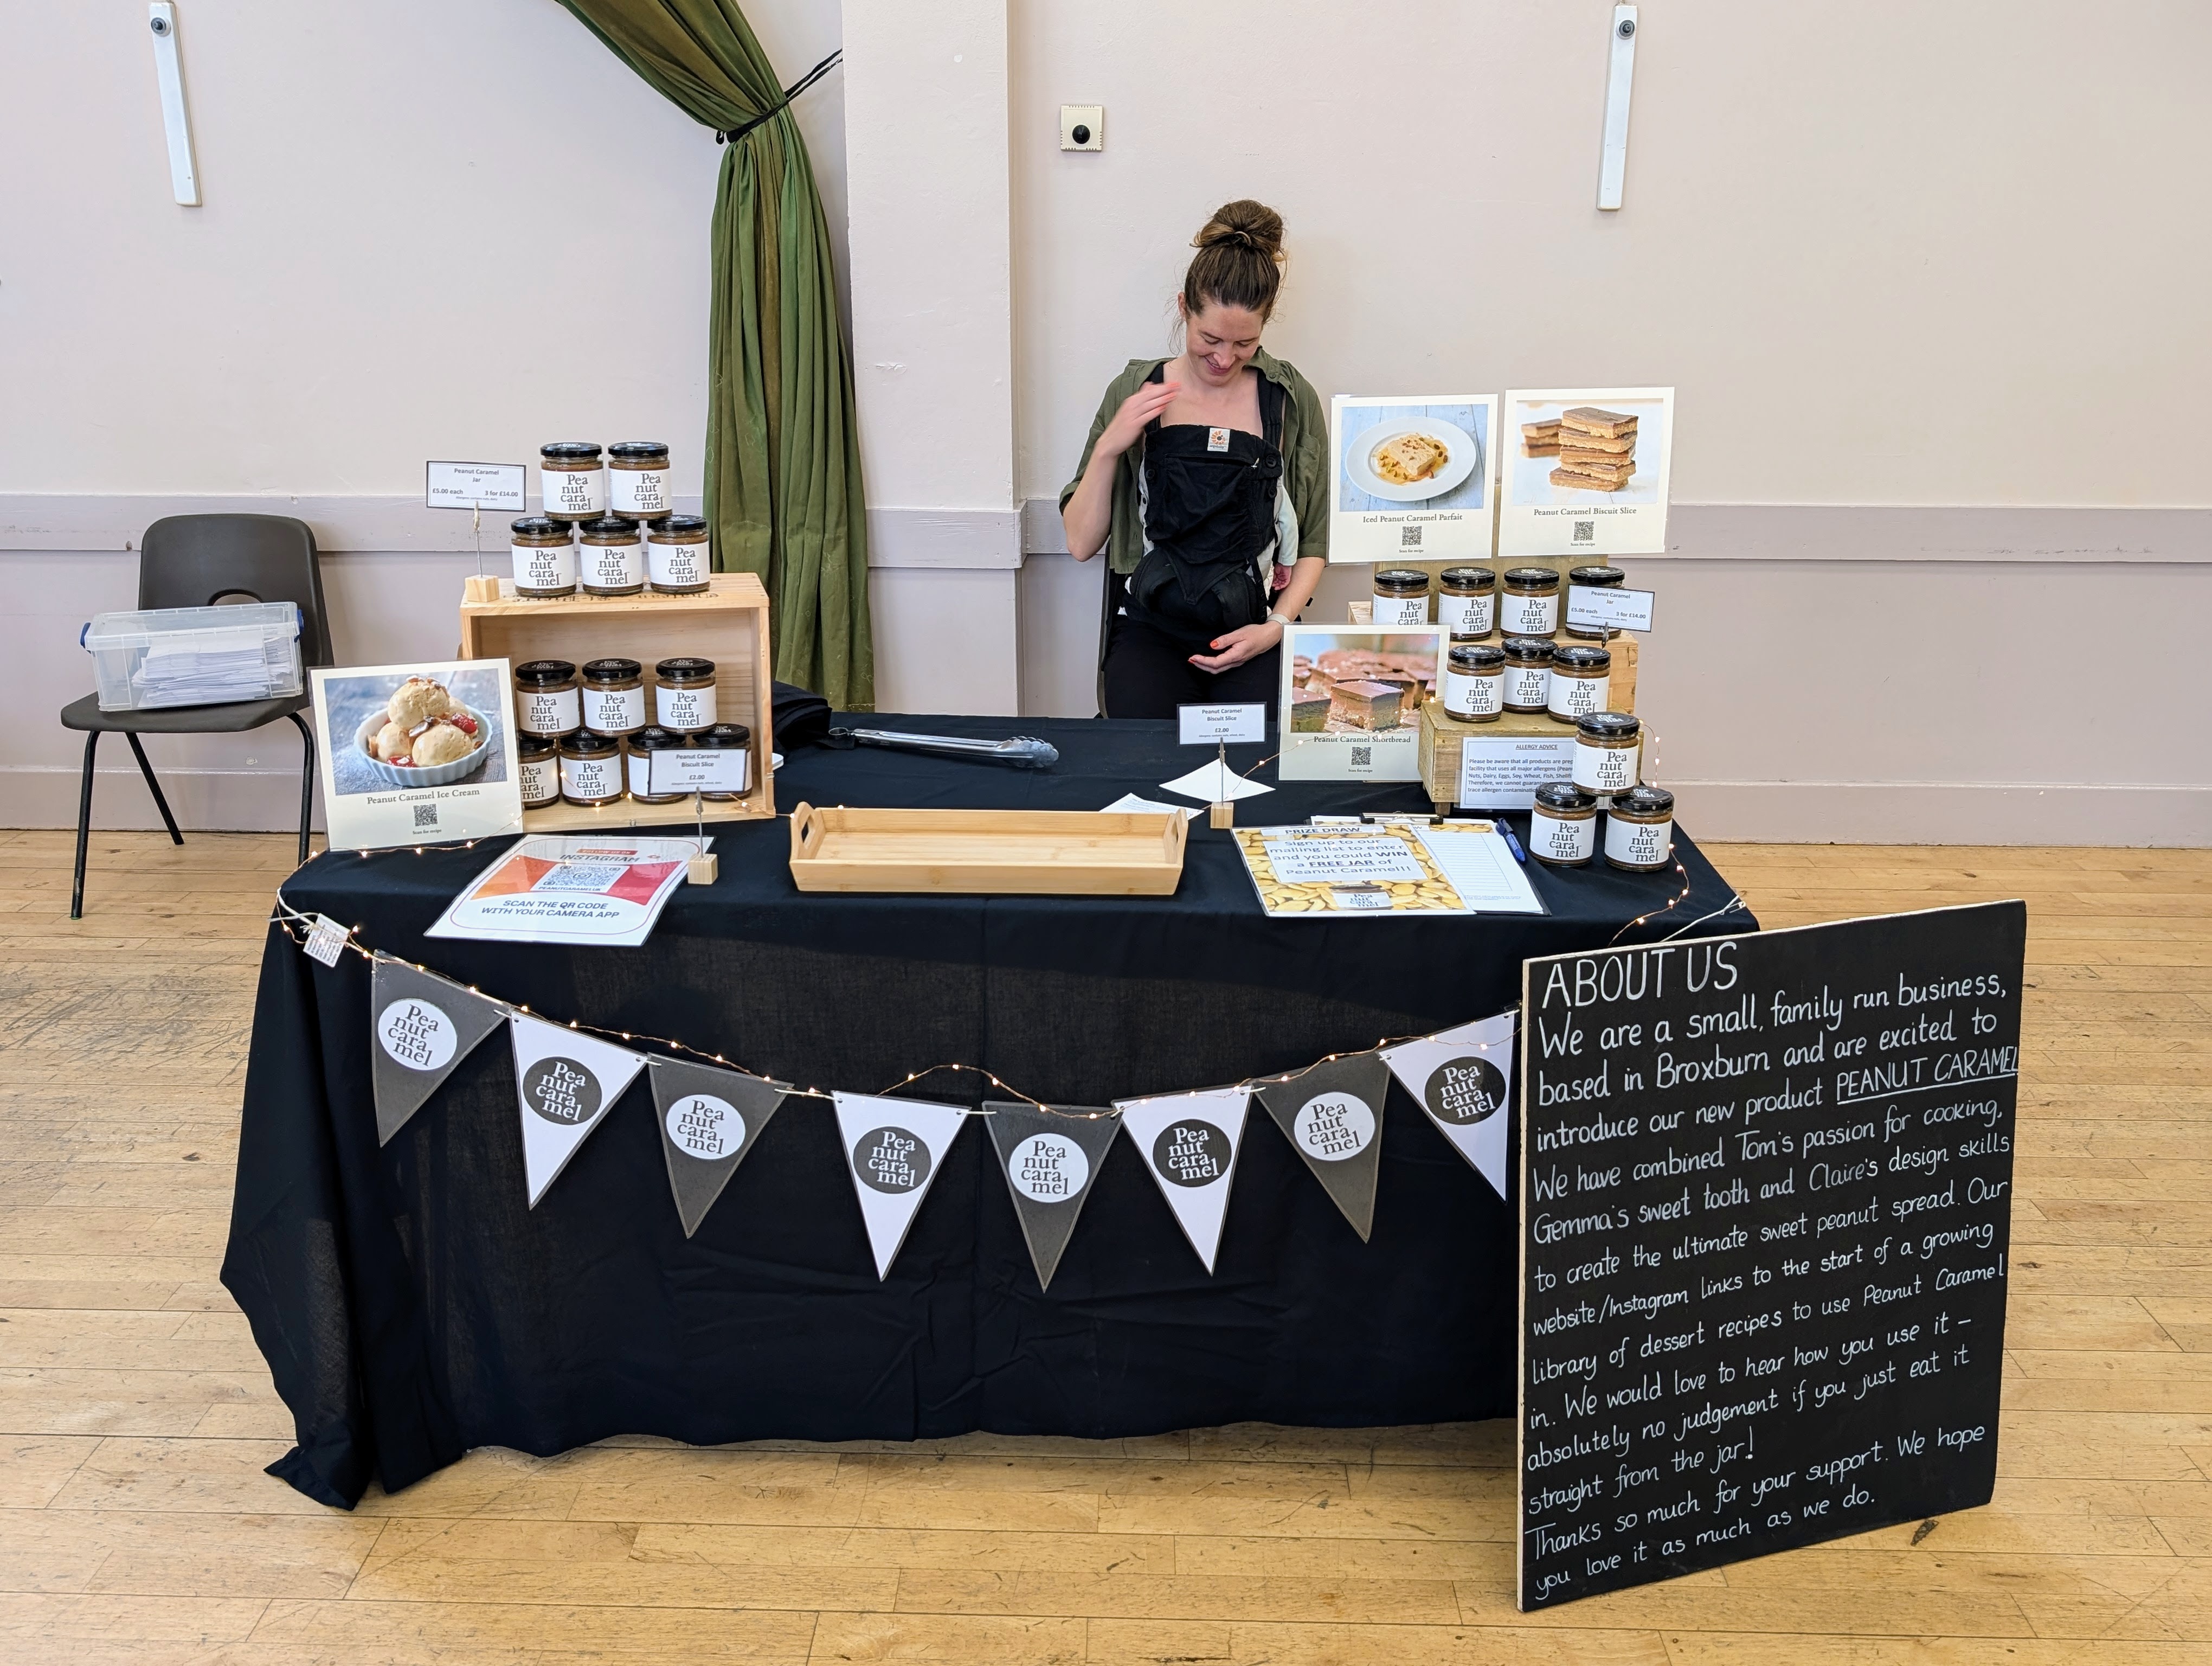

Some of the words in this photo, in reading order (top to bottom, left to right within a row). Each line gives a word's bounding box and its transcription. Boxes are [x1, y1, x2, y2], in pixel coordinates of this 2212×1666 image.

[567, 475, 588, 485] Pea
[562, 485, 583, 494] nut
[569, 498, 591, 510] mel
[1599, 761, 1622, 770] nut
[1607, 752, 1627, 762] Pea
[1597, 770, 1622, 779] cara
[1604, 774, 1626, 787] mel
[398, 791, 434, 801] Caramel
[1638, 826, 1659, 837] Pea
[1629, 845, 1654, 854] cara
[1635, 849, 1658, 862] mel
[1542, 947, 1675, 1009] ABOUT
[1687, 941, 1737, 992] US
[1539, 1011, 1583, 1059] We
[1600, 1023, 1642, 1051] are
[1655, 1021, 1673, 1043] a
[1686, 993, 1763, 1038] small,
[1770, 985, 1843, 1029] family
[1854, 986, 1889, 1008] run
[1899, 972, 2006, 1008] business,
[552, 1061, 586, 1086] Pea
[541, 1074, 577, 1094] nut
[536, 1085, 576, 1107] cara
[1537, 1108, 1638, 1152] introduce
[1649, 1111, 1684, 1135] our
[1695, 1101, 1734, 1125] new
[1745, 1085, 1823, 1126] product
[1837, 1060, 1922, 1100] PEANUT
[1934, 1046, 2018, 1082] CARAMEL
[542, 1100, 582, 1122] mel
[1311, 1103, 1348, 1120] Pea
[1308, 1116, 1343, 1133] nut
[1309, 1128, 1351, 1145] cara
[1323, 1131, 1361, 1155] mel
[1033, 1140, 1066, 1158] Pea
[1024, 1156, 1059, 1169] nut
[1021, 1169, 1062, 1182] cara
[1031, 1178, 1069, 1195] mel
[1534, 1203, 1629, 1244] Gemma's
[1639, 1196, 1690, 1224] sweet
[1704, 1182, 1750, 1211] tooth
[1760, 1169, 1795, 1201] and
[1809, 1159, 1878, 1193] Claire's
[1888, 1144, 1949, 1176] design
[1958, 1133, 2009, 1159] skills
[1533, 1353, 1597, 1385] library
[1609, 1337, 1629, 1369] of
[1639, 1326, 1705, 1357] dessert
[1718, 1311, 1782, 1342] recipes
[1793, 1302, 1811, 1321] to
[1822, 1296, 1850, 1316] use
[1864, 1280, 1922, 1309] Peanut
[1935, 1258, 2004, 1291] Caramel
[1526, 1521, 1602, 1560] Thanks
[1614, 1513, 1637, 1533] so
[1647, 1496, 1700, 1523] much
[1714, 1481, 1738, 1514] for
[1752, 1471, 1795, 1507] your
[1806, 1443, 1889, 1481] support.
[1897, 1433, 1925, 1458] We
[1937, 1425, 1985, 1455] hope
